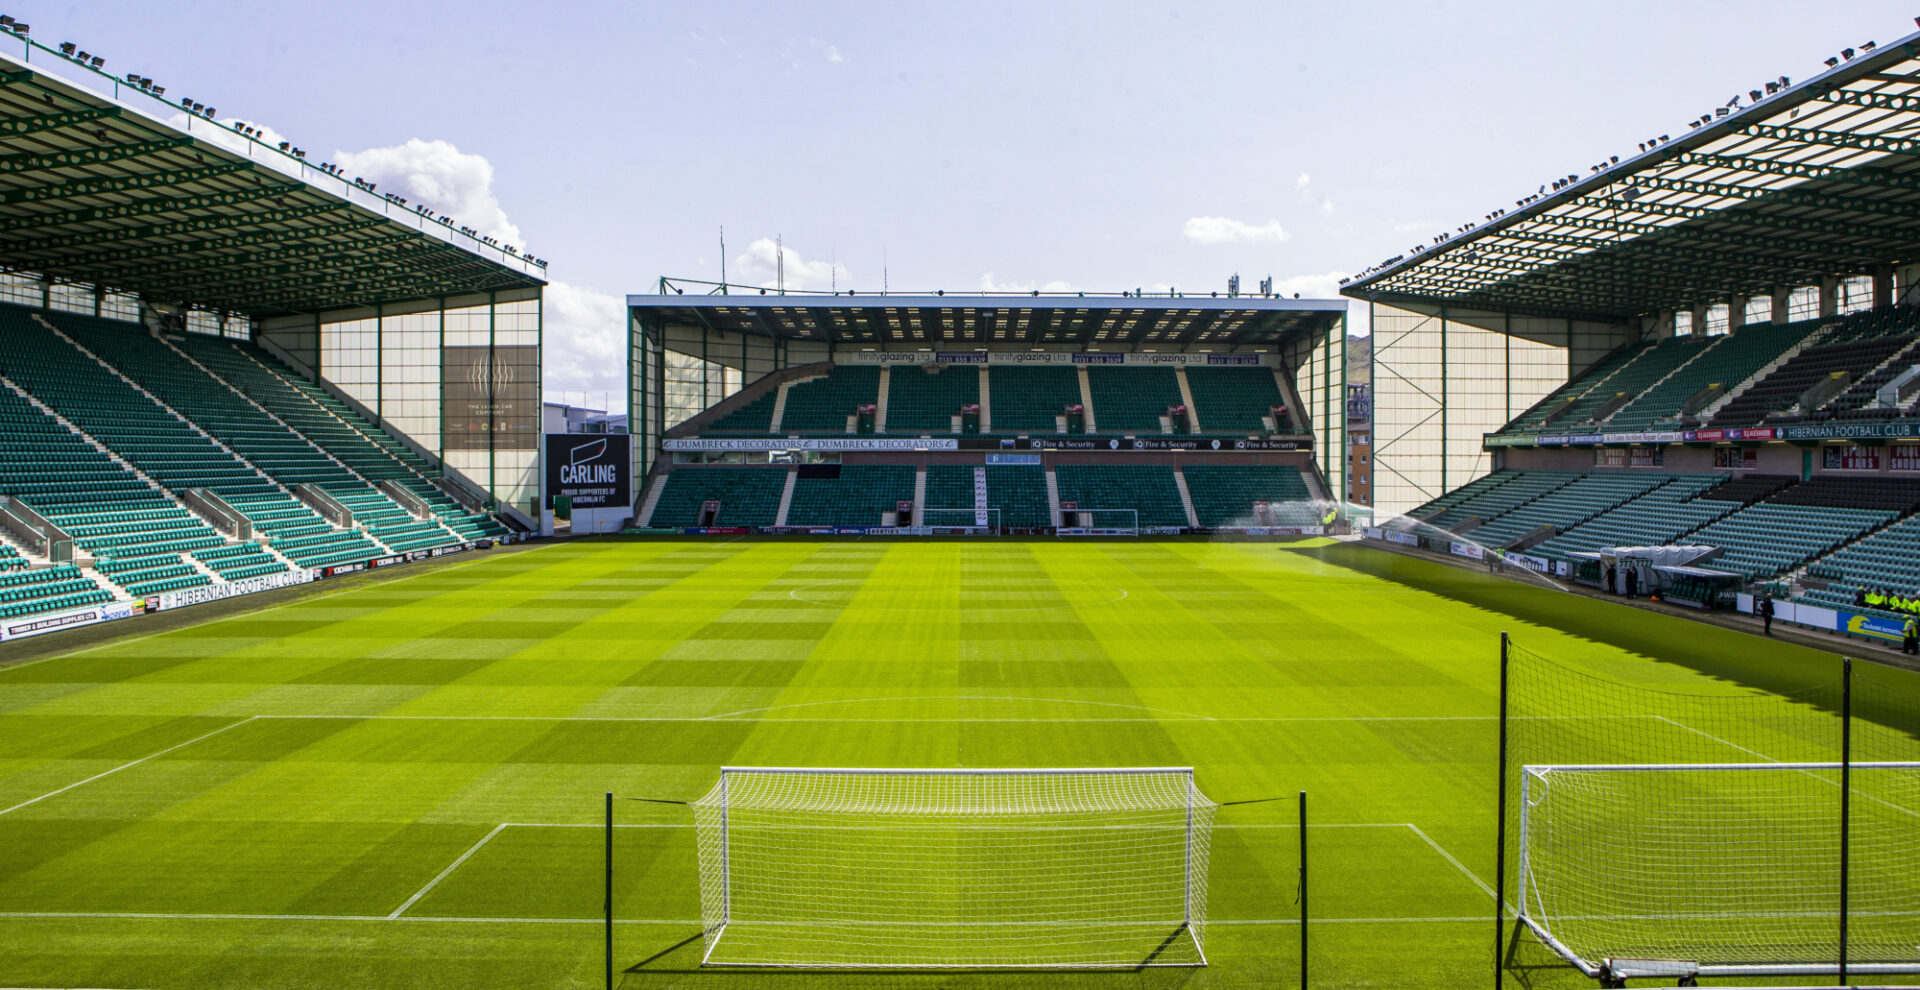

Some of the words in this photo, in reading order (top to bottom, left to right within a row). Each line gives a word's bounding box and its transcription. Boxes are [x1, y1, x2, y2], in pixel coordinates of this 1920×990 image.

[1788, 427, 1834, 438] HIBERNIAN
[1835, 426, 1881, 437] FOOTBALL
[1884, 425, 1910, 437] CLUB
[677, 440, 734, 448] DUMBRECK
[737, 440, 802, 448] DECORATORS
[817, 440, 875, 448] DUMBRECK
[878, 440, 944, 448] DECORATORS
[1043, 440, 1056, 448] Fire
[1058, 440, 1064, 448] &
[1066, 440, 1096, 449] Security
[1145, 440, 1159, 448] Fire
[1160, 440, 1167, 448] &
[1168, 440, 1198, 449] Security
[1247, 440, 1260, 448] Fire
[1261, 440, 1268, 448] &
[1269, 440, 1298, 449] Security
[1843, 446, 1879, 457] SPORTS
[1896, 446, 1919, 457] POOL
[1848, 458, 1873, 469] BARS
[560, 464, 616, 484] CARLING
[579, 488, 609, 496] SUPPORTERS
[175, 583, 232, 606] HIBERNIAN
[234, 574, 281, 594] FOOTBALL
[282, 571, 304, 587] CLUB
[10, 624, 31, 635] TIMBER
